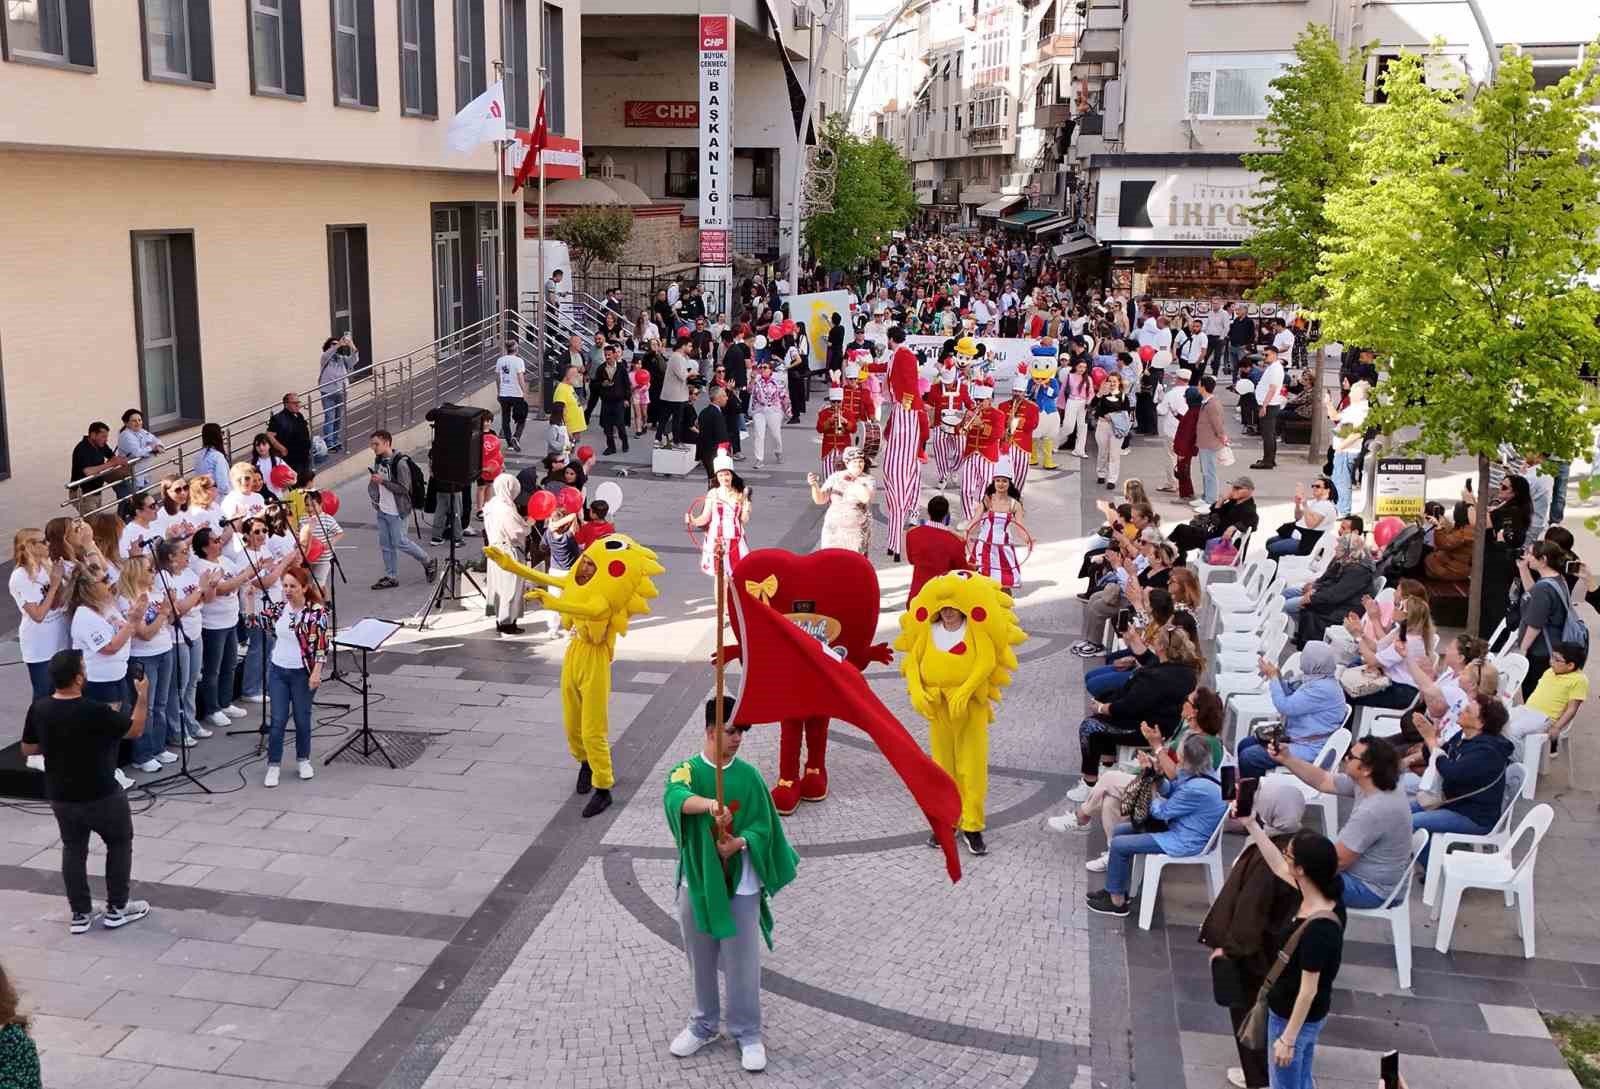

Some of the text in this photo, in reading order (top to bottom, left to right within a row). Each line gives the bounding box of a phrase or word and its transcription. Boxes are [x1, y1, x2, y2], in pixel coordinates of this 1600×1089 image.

[703, 38, 724, 47] CHP
[655, 104, 697, 118] CHP
[708, 81, 720, 216] BAŞKANLIĞI
